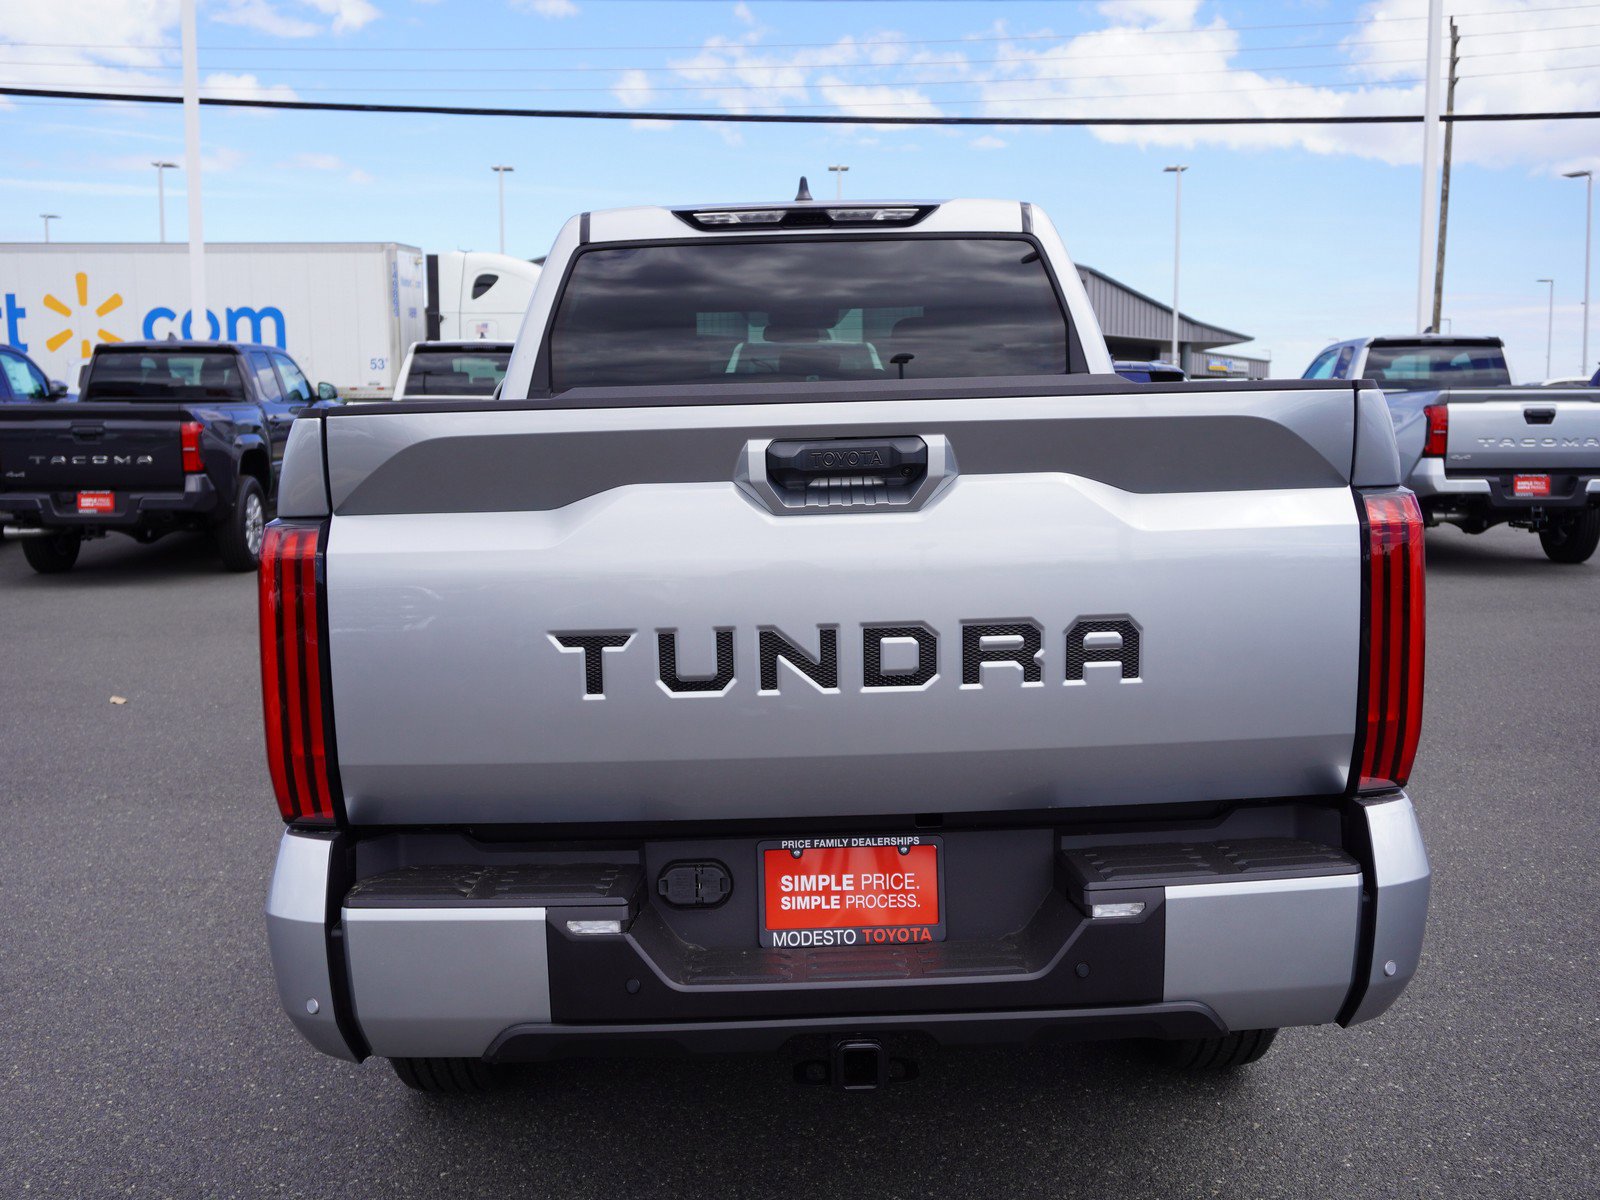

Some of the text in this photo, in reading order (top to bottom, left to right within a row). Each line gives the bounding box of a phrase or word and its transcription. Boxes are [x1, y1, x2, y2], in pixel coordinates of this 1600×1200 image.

[1477, 437, 1600, 448] TACOMA
[28, 455, 153, 464] TACOMA
[810, 450, 884, 469] TOYOTA
[546, 613, 1144, 701] TUNDRA
[781, 836, 920, 849] PRICE FAMILY DEALERSHIPS
[780, 873, 920, 892] SIMPLE PRICE.
[780, 894, 921, 910] SIMPLE PROCESS.
[772, 927, 932, 947] MODESTO TOYOTA
